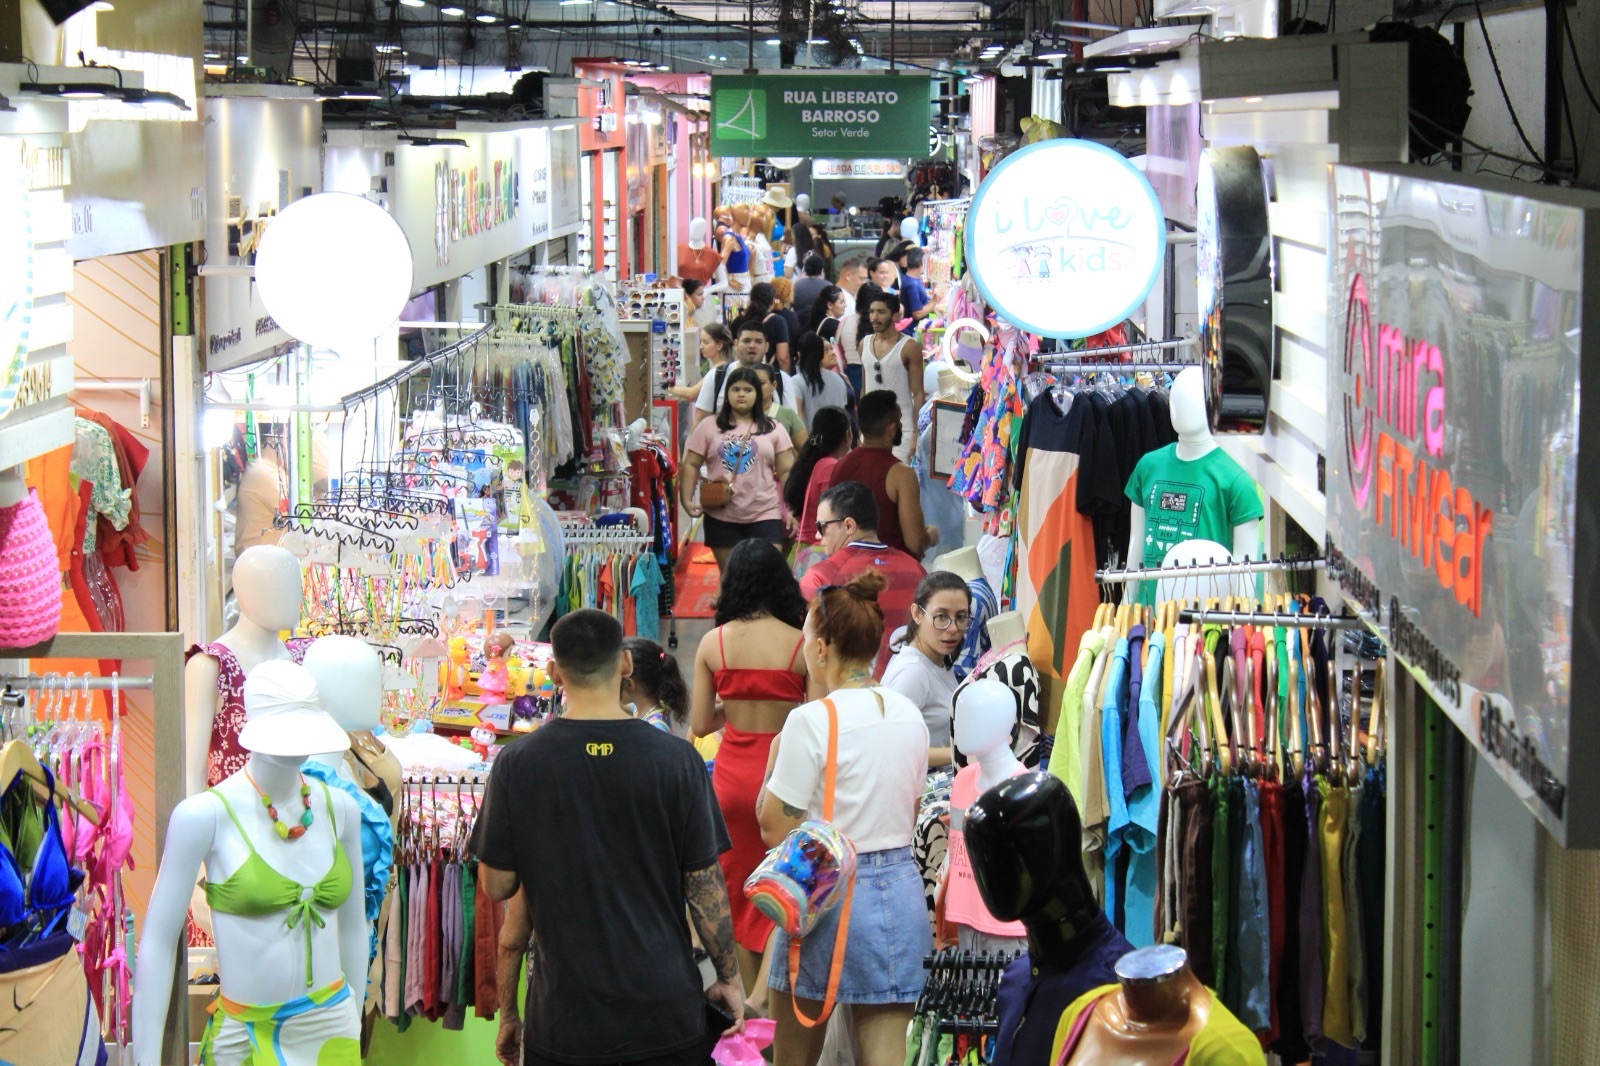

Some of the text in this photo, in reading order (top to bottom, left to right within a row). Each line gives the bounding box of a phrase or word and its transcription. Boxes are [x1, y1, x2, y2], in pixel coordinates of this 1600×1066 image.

[783, 91, 899, 105] RUA LIBERATO
[801, 109, 880, 123] BARROSO
[811, 127, 870, 138] Setor Verde
[854, 164, 867, 174] DE
[1058, 246, 1123, 273] kids
[1377, 322, 1445, 459] mira
